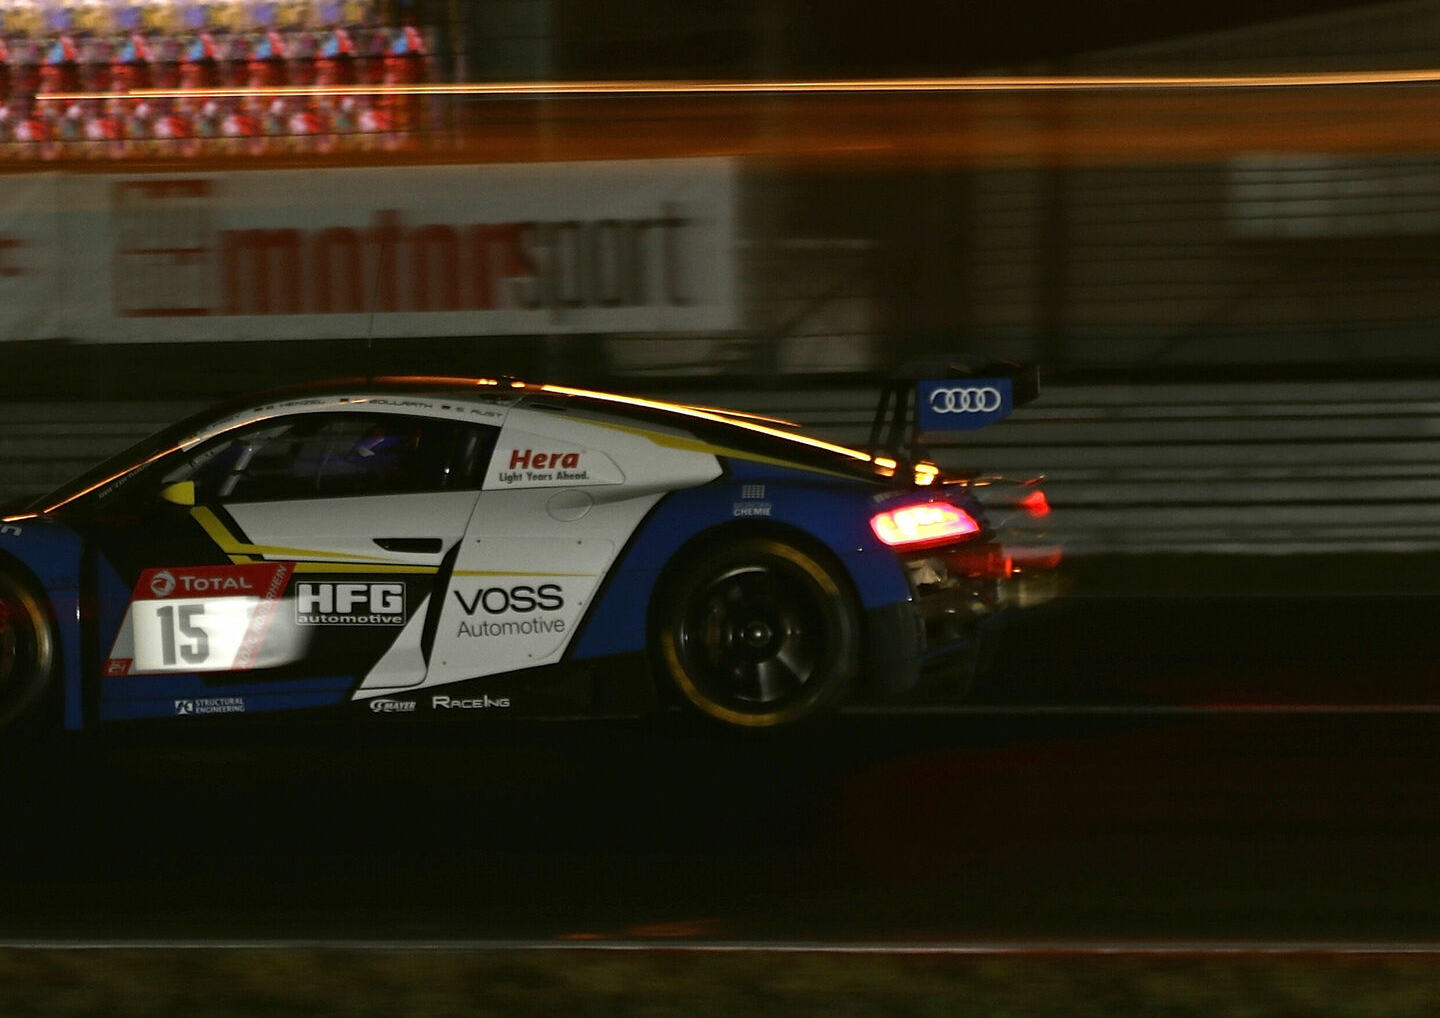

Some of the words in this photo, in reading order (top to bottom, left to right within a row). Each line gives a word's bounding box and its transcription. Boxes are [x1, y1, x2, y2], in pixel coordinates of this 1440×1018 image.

[216, 202, 695, 326] motorsport
[509, 449, 580, 470] Hera
[499, 472, 523, 484] Light
[526, 472, 553, 481] Years
[733, 507, 772, 517] CHEMIE
[180, 575, 253, 591] TOTAL
[298, 584, 403, 614] HFG
[454, 584, 564, 615] VOSS
[298, 614, 403, 623] automotive
[457, 617, 566, 638] Automotive
[156, 603, 210, 666] 15
[195, 697, 244, 707] STRUCTURAL
[195, 704, 246, 714] ENGINEERING
